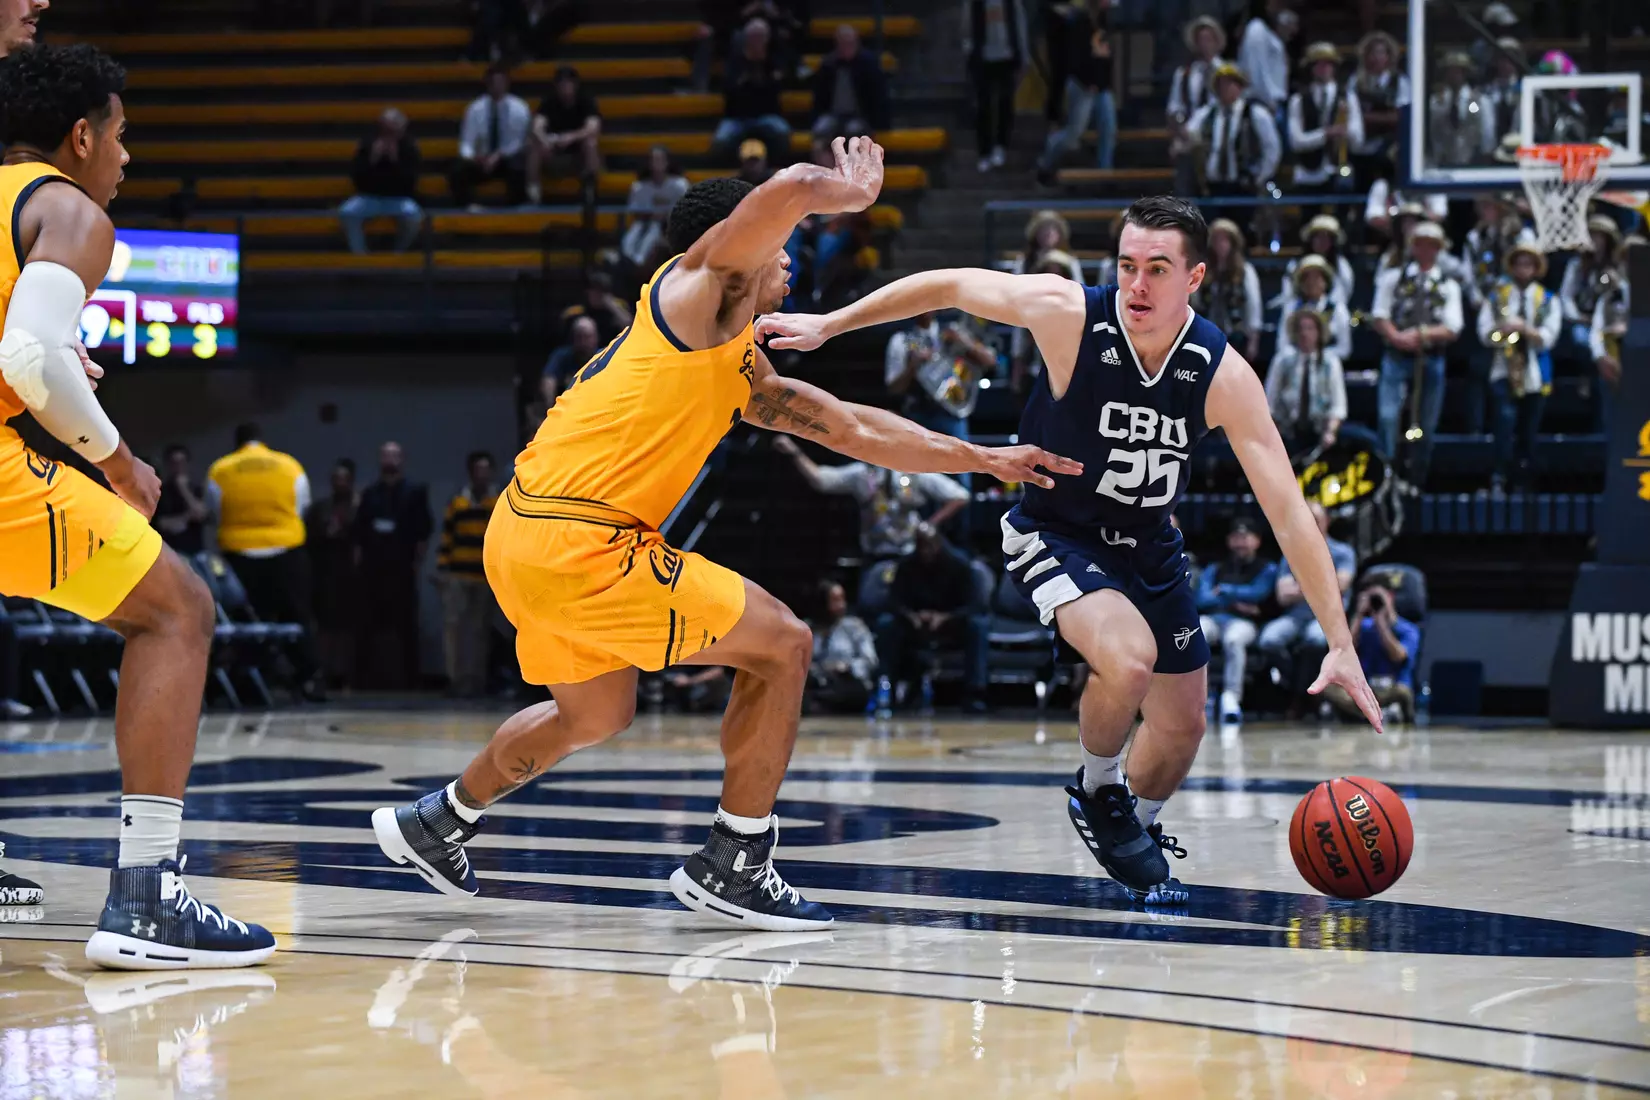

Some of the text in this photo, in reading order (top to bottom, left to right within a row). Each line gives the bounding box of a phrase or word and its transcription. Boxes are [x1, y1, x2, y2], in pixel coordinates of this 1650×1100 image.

[1173, 367, 1199, 382] WAC
[1098, 401, 1189, 448] CBU
[1095, 448, 1190, 508] 25
[1314, 820, 1350, 879] NCAA
[1345, 793, 1385, 876] Wilson
